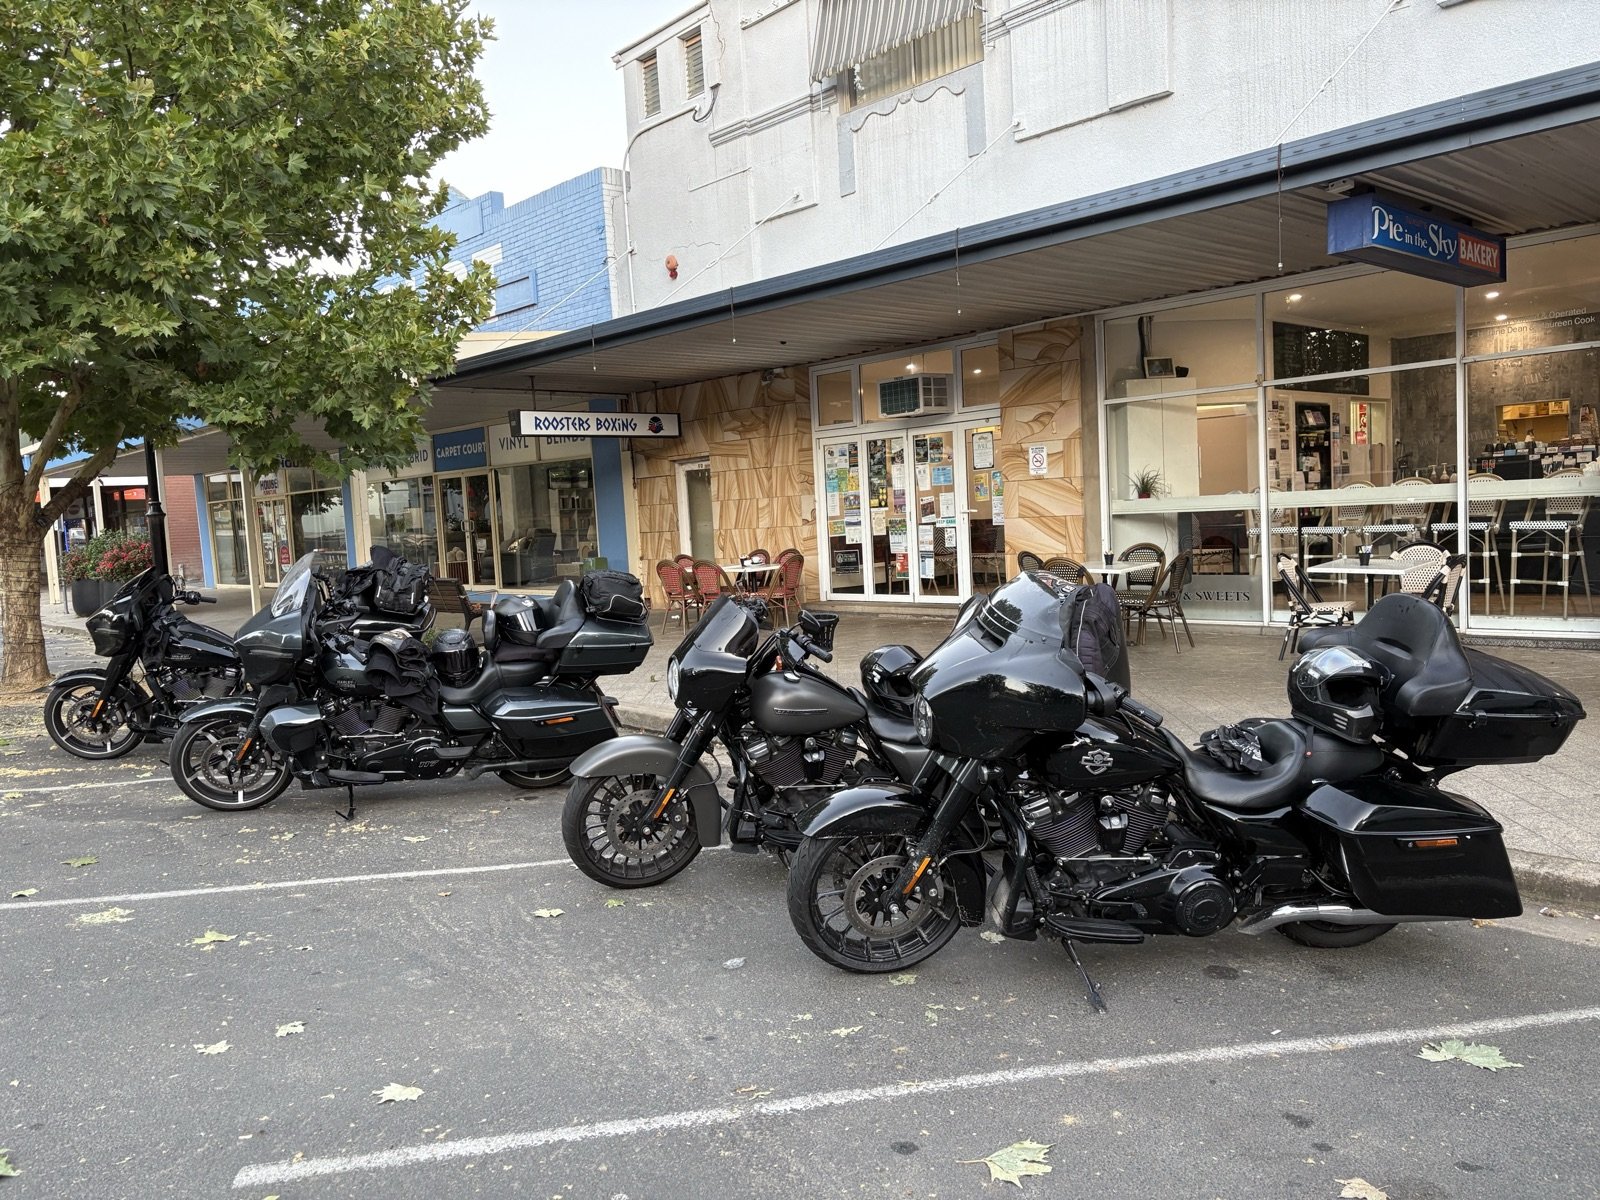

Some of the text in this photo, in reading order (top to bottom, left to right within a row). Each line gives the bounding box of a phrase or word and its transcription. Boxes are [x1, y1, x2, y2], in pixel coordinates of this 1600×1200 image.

[1372, 206, 1403, 241] Pie
[1405, 229, 1413, 244] in
[1415, 232, 1428, 249] the
[1428, 223, 1457, 260] Sky
[1460, 238, 1498, 268] BAKERY
[1549, 307, 1587, 319] Operated
[1507, 325, 1528, 334] Dean
[1542, 318, 1574, 329] aureen
[1574, 316, 1596, 325] Cook
[534, 416, 591, 431] ROOSTERS
[436, 441, 486, 459] CARPET COURT
[498, 436, 529, 451] VINYL
[1183, 592, 1191, 601] &
[1195, 590, 1250, 602] SWEETS
